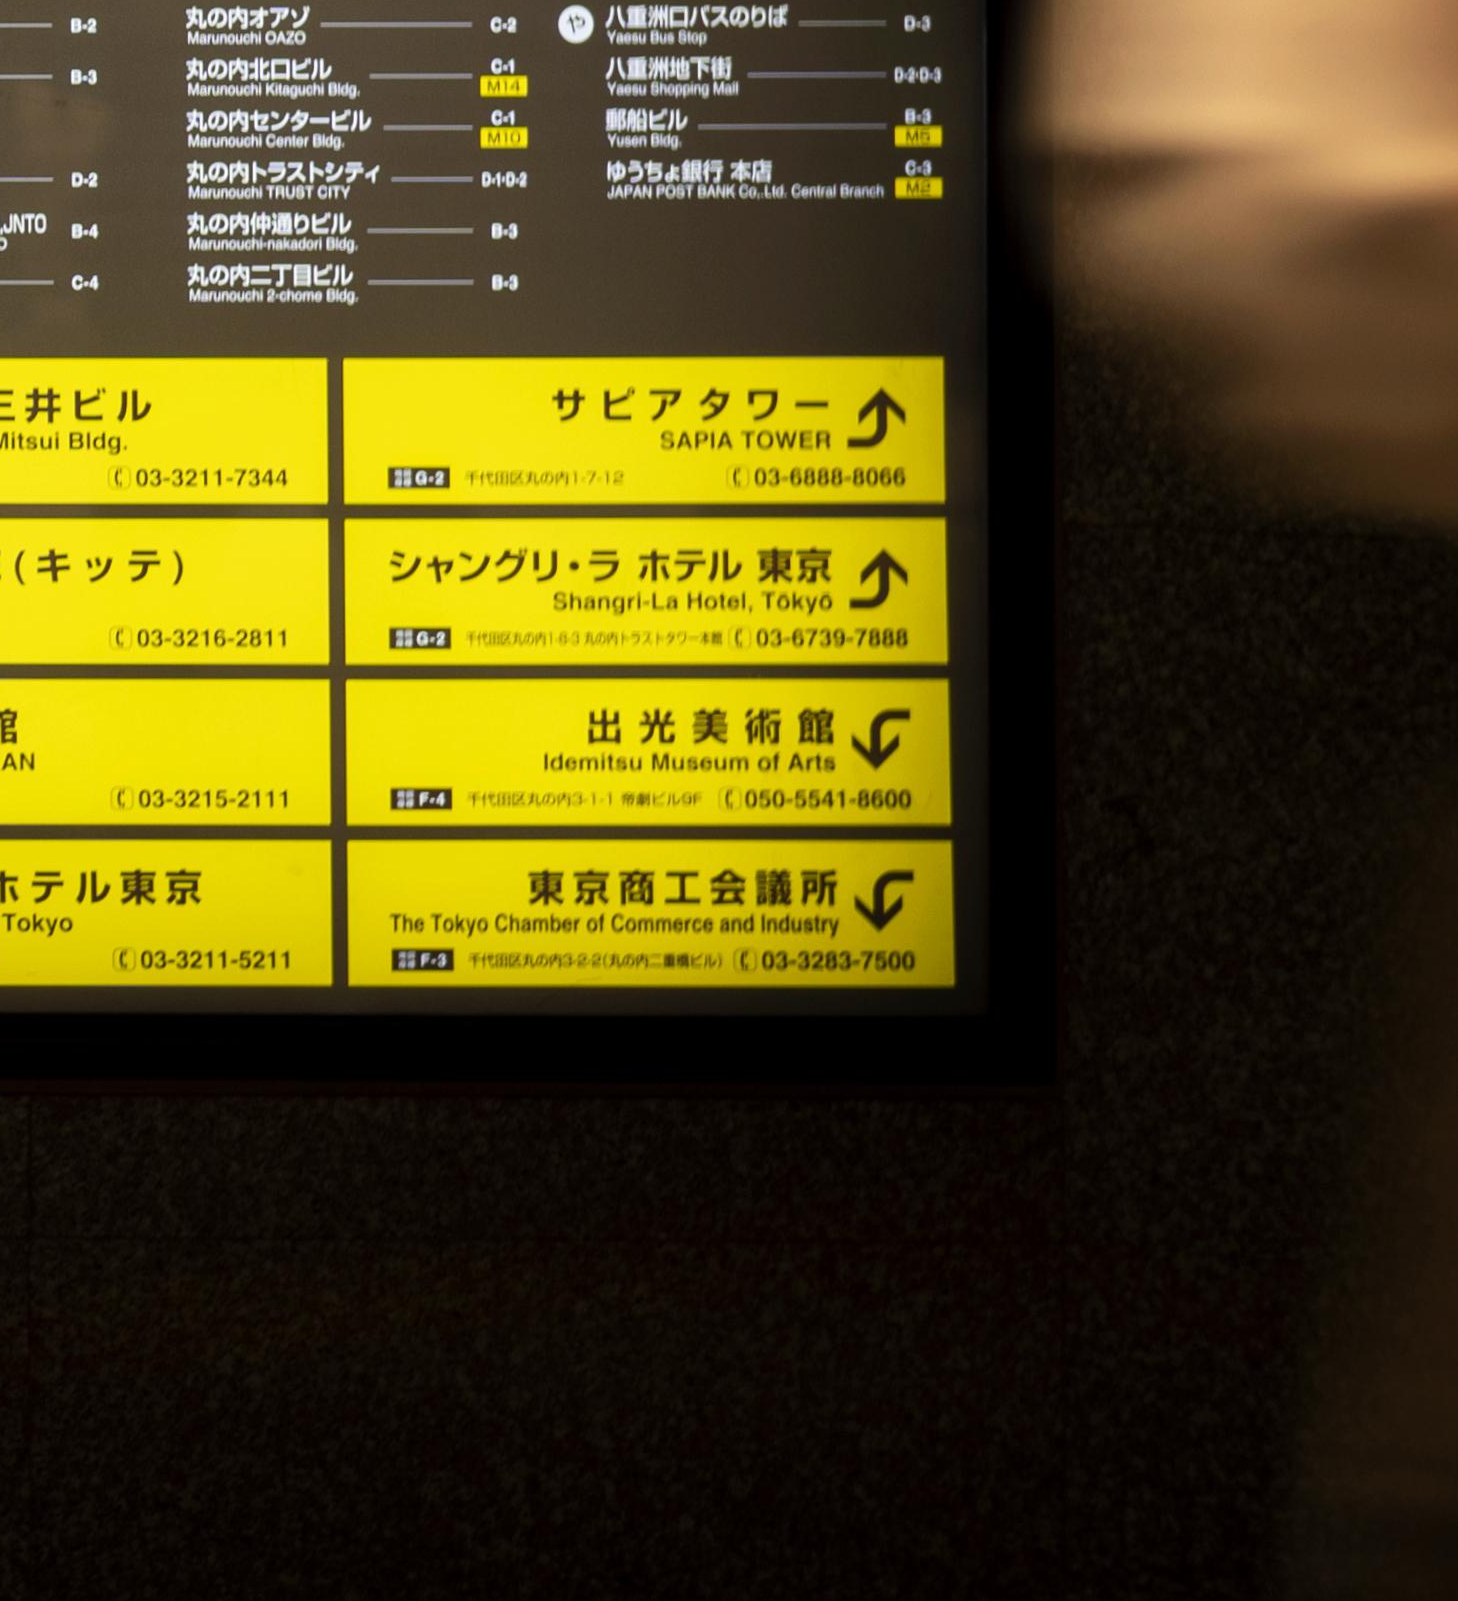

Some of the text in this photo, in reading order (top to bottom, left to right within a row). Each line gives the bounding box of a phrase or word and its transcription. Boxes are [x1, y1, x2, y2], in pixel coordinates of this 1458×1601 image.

[603, 54, 736, 83] 八重洲地下街
[183, 159, 384, 184] 丸の内トラストシティ
[552, 387, 830, 422] サピアタワー
[68, 431, 127, 455] Bldg.
[660, 430, 831, 450] SAPIA TOWER
[135, 468, 288, 487] 03-3211-7344
[751, 465, 906, 490] 03-6888-8066
[638, 549, 743, 582] ホテル
[757, 546, 833, 585] 東京
[552, 590, 834, 616] Shangri-La Hotel, Tōkyō
[136, 629, 287, 648] 03-3216-2811
[752, 626, 909, 651] 03-6739-7888
[588, 708, 835, 745] 出光美術館
[543, 752, 837, 773] Idemitsu Museum of Arts
[138, 789, 288, 809] 03-3215-2111
[741, 786, 913, 813] 050-5541-8600
[523, 866, 838, 910] 東京商工会議所
[1, 912, 74, 938] Tokyo
[391, 910, 840, 939] The Tokyo Chamber of Commerce and Industry
[140, 950, 290, 970] 03-3211-5211
[758, 947, 916, 975] 03-3283-7500
